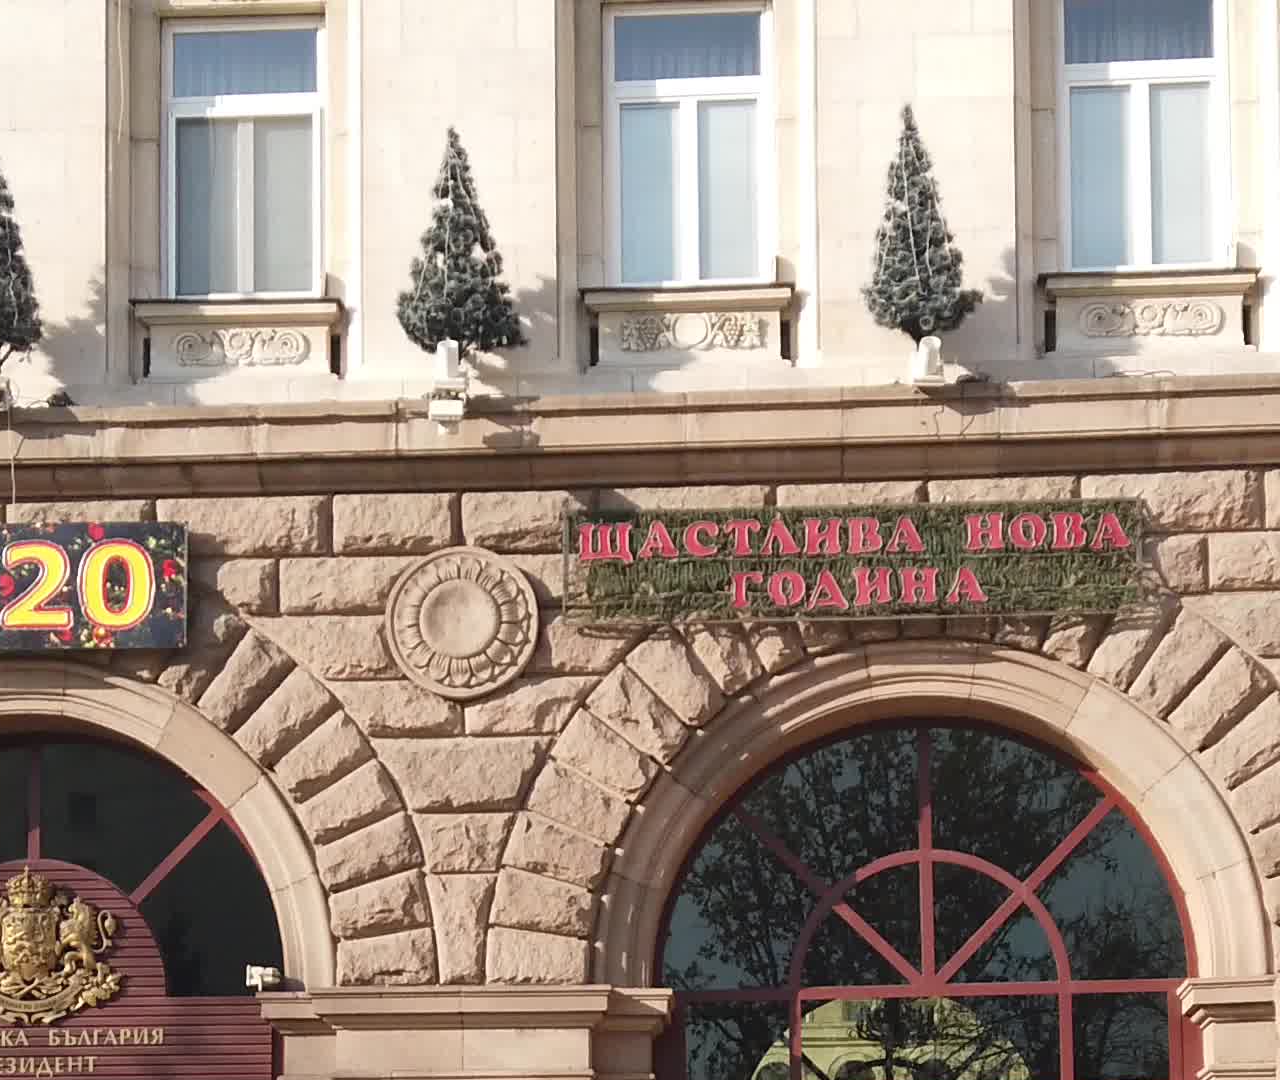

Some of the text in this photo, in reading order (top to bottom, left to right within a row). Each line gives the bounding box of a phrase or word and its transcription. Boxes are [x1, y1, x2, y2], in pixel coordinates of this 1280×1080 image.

[578, 511, 1132, 564] ЩАСТЛИВА НОВА
[731, 566, 989, 610] ГОДИНА
[48, 1027, 164, 1047] БЪЛГАРИЯ
